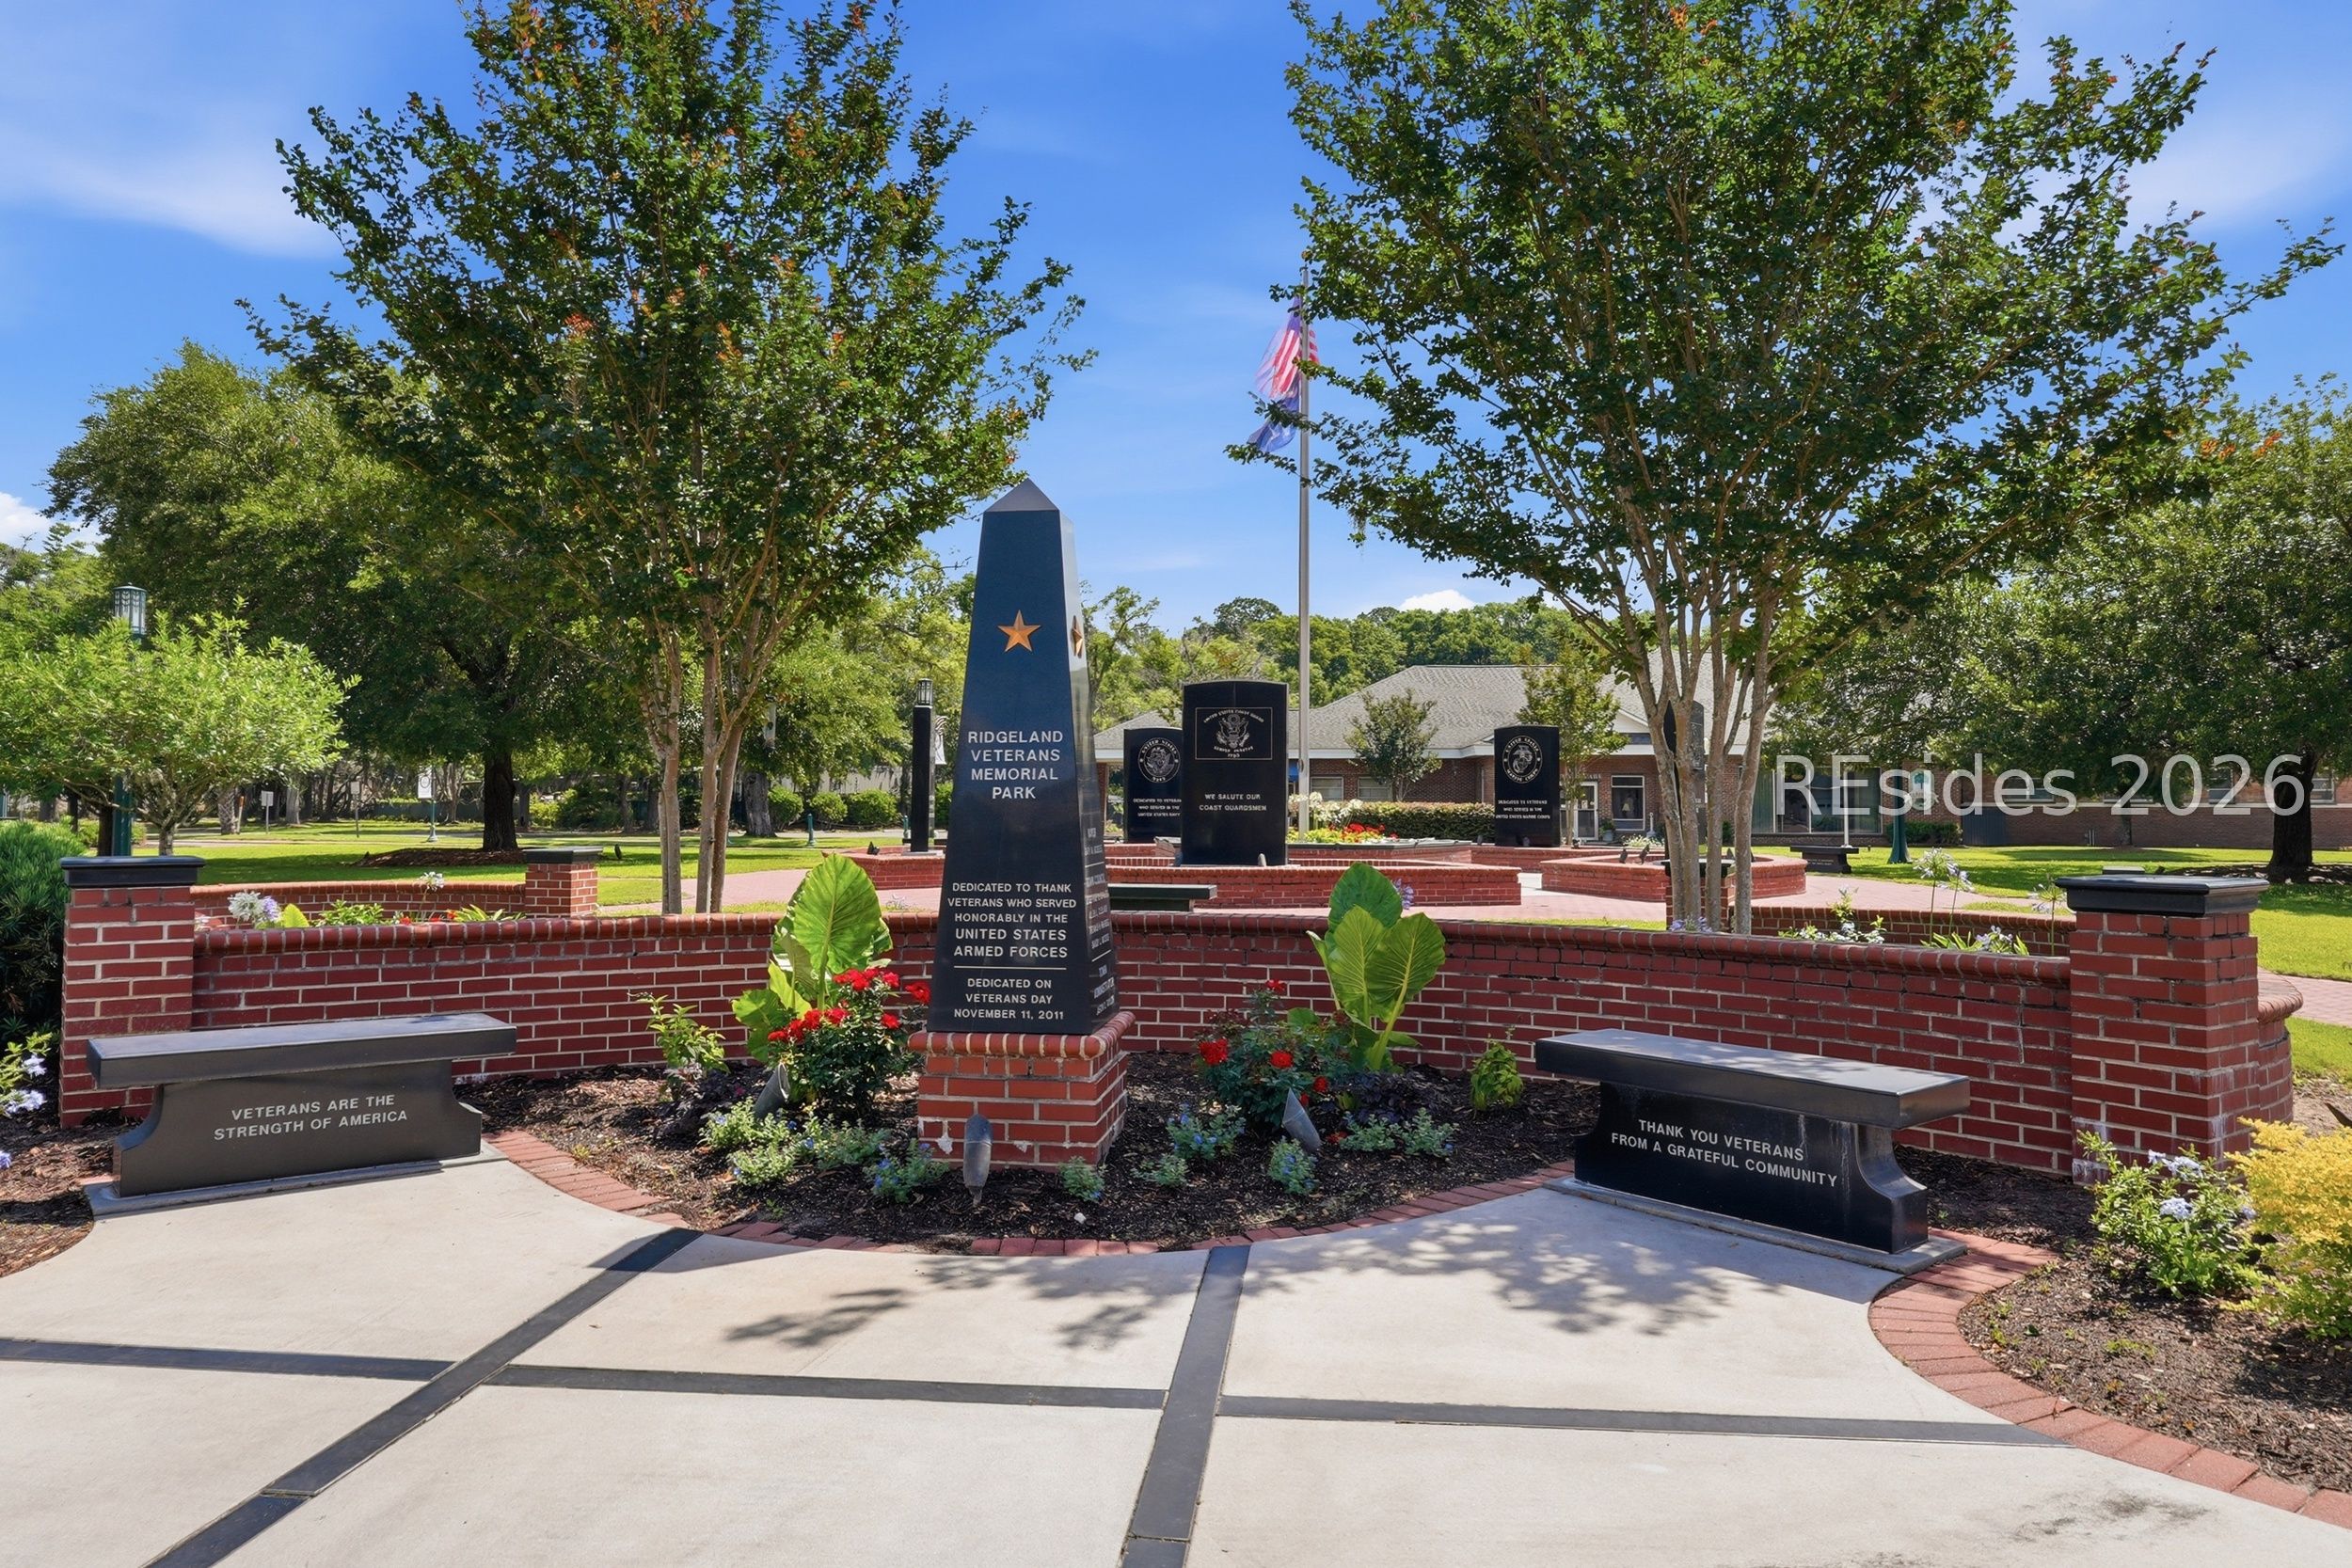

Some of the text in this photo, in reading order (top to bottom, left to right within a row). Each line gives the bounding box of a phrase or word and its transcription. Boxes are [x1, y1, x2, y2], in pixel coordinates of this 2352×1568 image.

[968, 731, 1062, 743] RIDGELAND
[971, 750, 1059, 761] VETERANS
[972, 768, 1057, 780] MEMORIAL
[993, 787, 1035, 799] PARK
[953, 883, 1011, 892] DEDICATED
[1035, 884, 1071, 893] THANK
[948, 898, 1003, 907] VETERANS
[1036, 899, 1076, 908] SERVED
[955, 913, 1068, 923] HONORABLY IN THE
[956, 928, 1066, 941] UNITED STATES
[954, 946, 1067, 958] ARMED FORCES
[968, 978, 1030, 988] DEDICATED
[966, 994, 1052, 1004] VETERANS DAY
[955, 1009, 1063, 1020] NOVEMBER 11, 2011
[232, 1095, 394, 1120] VETERANS ARE THE
[215, 1110, 406, 1140] STRENGTH OF AMERICA
[1639, 1119, 1804, 1161] THANK YOU VETERANS
[1612, 1132, 1837, 1187] FROM A GRATEFUL COMMUNITY
